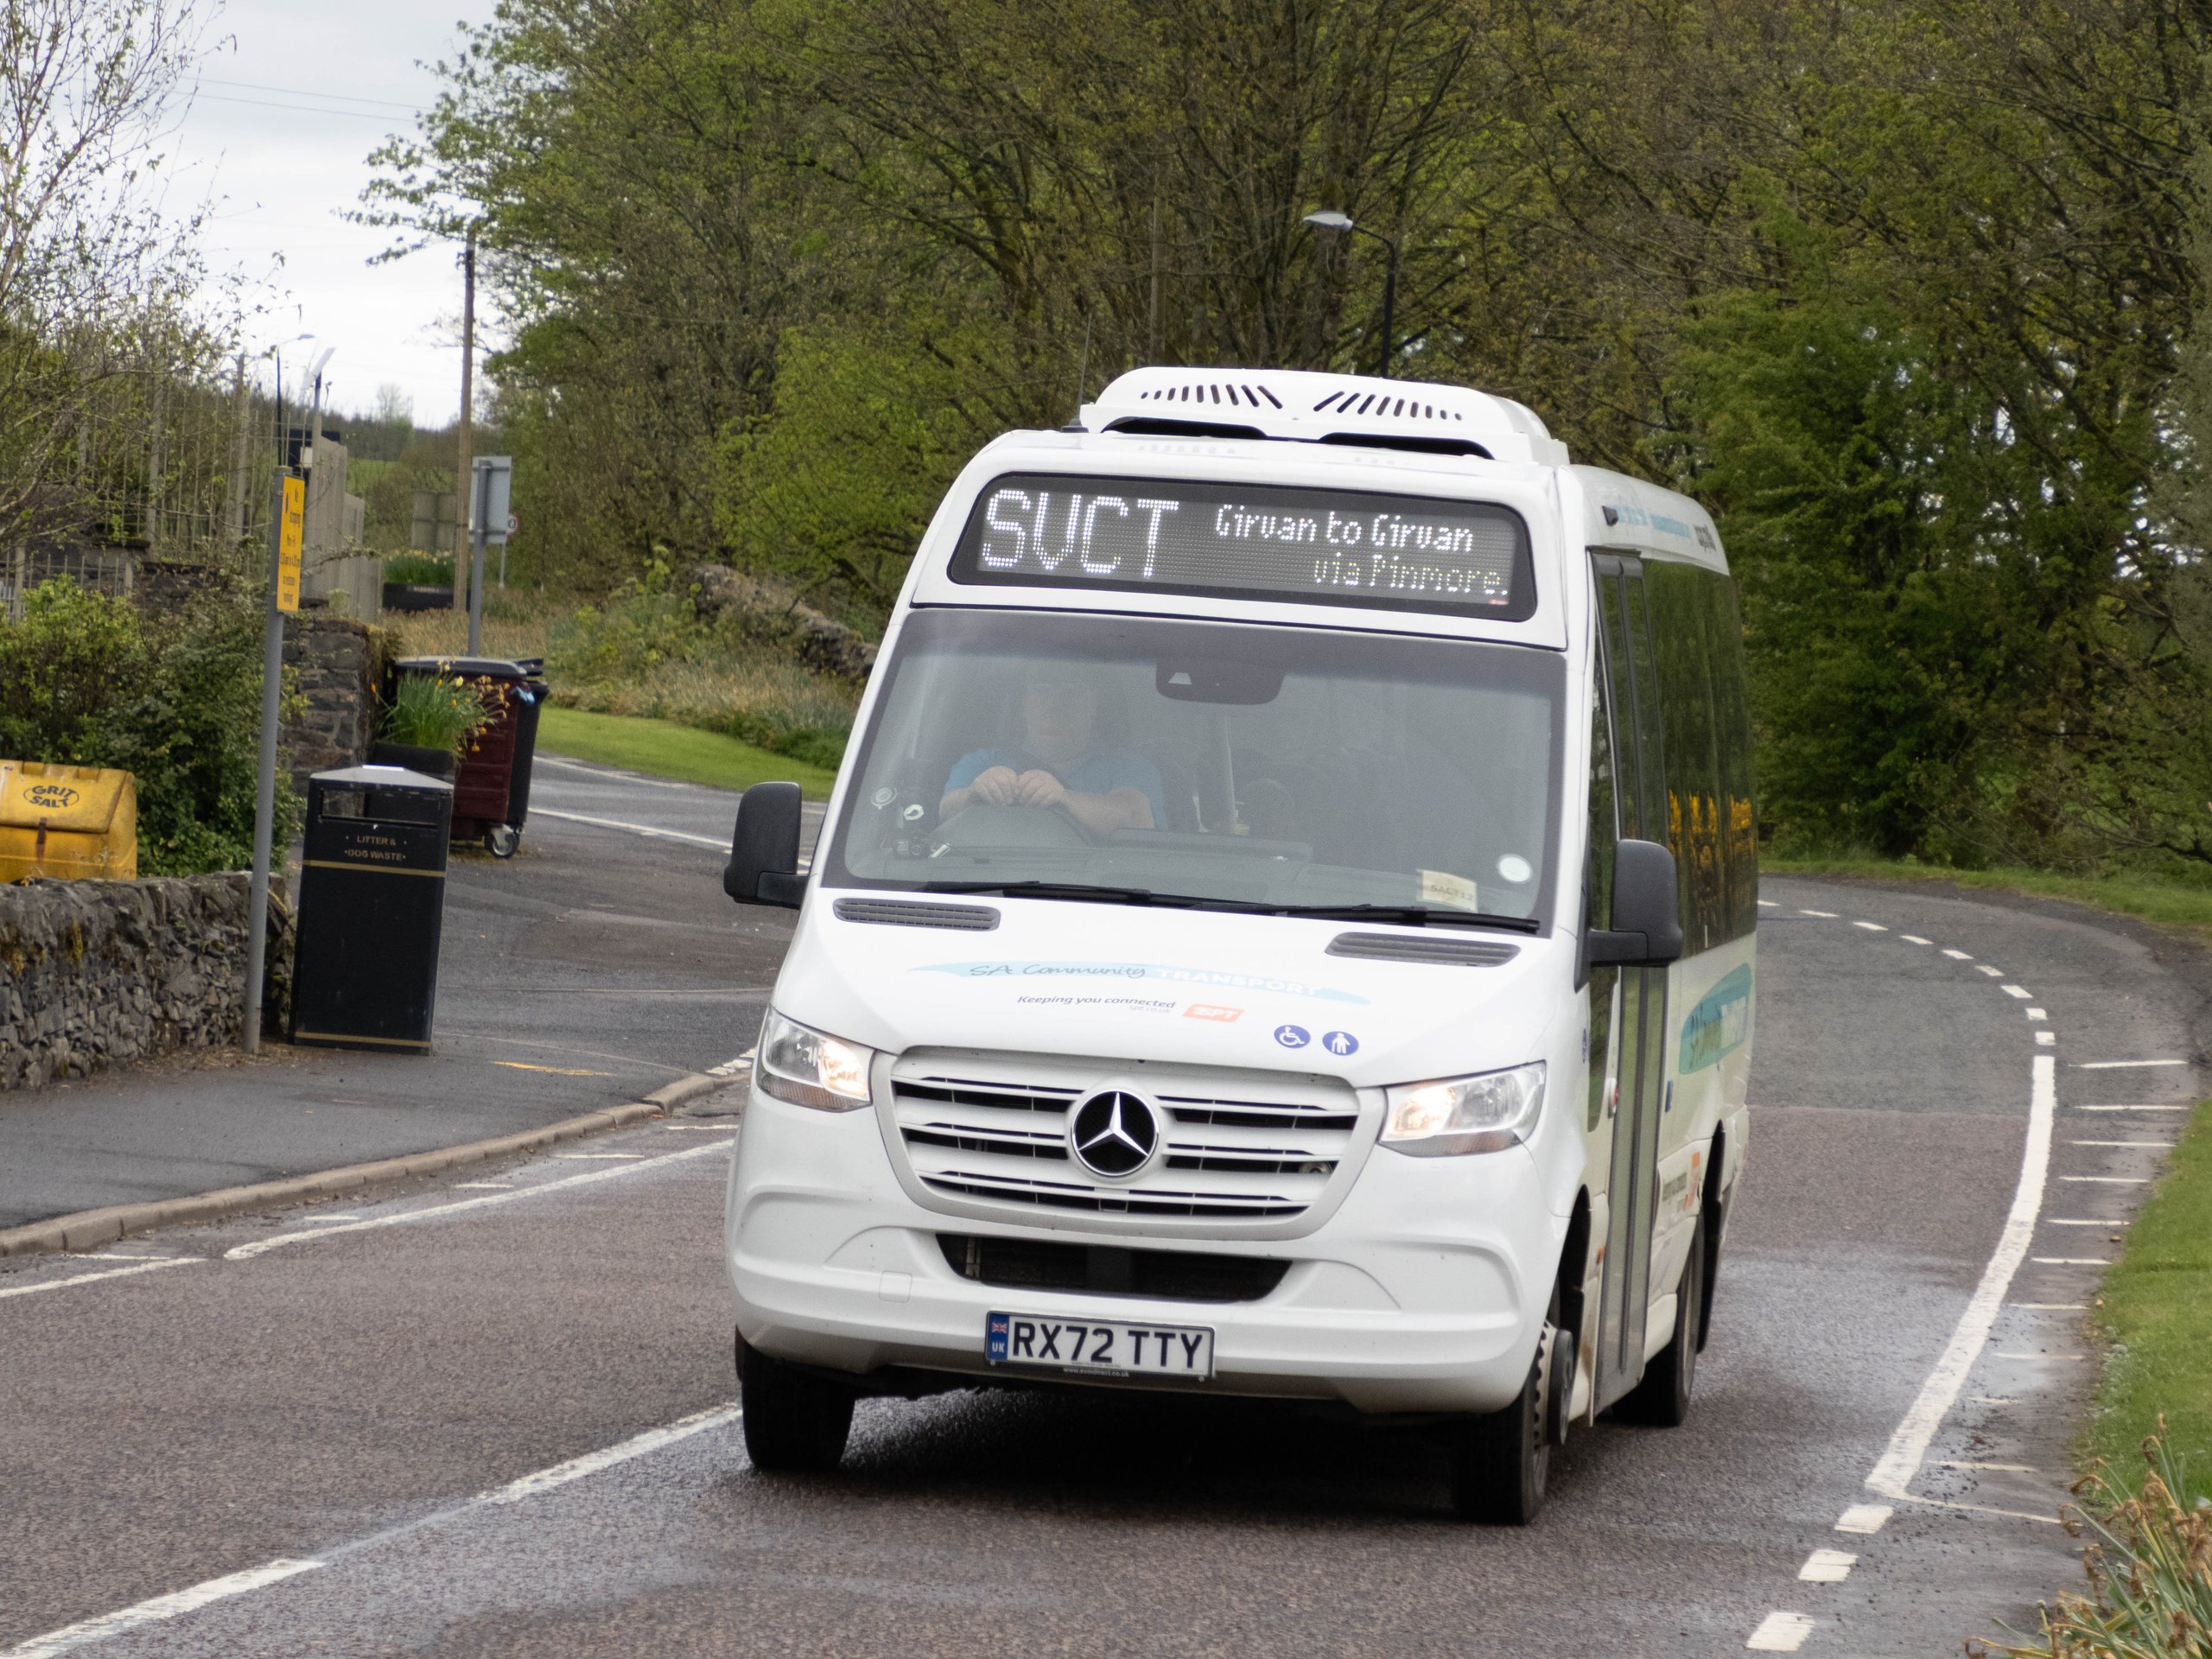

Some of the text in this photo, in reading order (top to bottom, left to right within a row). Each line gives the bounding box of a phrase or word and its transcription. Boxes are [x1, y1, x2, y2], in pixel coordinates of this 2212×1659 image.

[1216, 504, 1474, 552] Girvan to Girvan
[1314, 551, 1360, 586] via
[32, 785, 77, 798] GRIT
[29, 795, 69, 808] SALT
[357, 835, 397, 846] LITTER &
[347, 849, 402, 861] DOG WASTE
[969, 963, 1323, 997] SA Community TRANSPORT
[1017, 995, 1176, 1008] Keeping you connected
[1194, 1007, 1237, 1020] SPT
[992, 1341, 1005, 1354] UK
[1013, 1322, 1203, 1369] RX72 TTY
